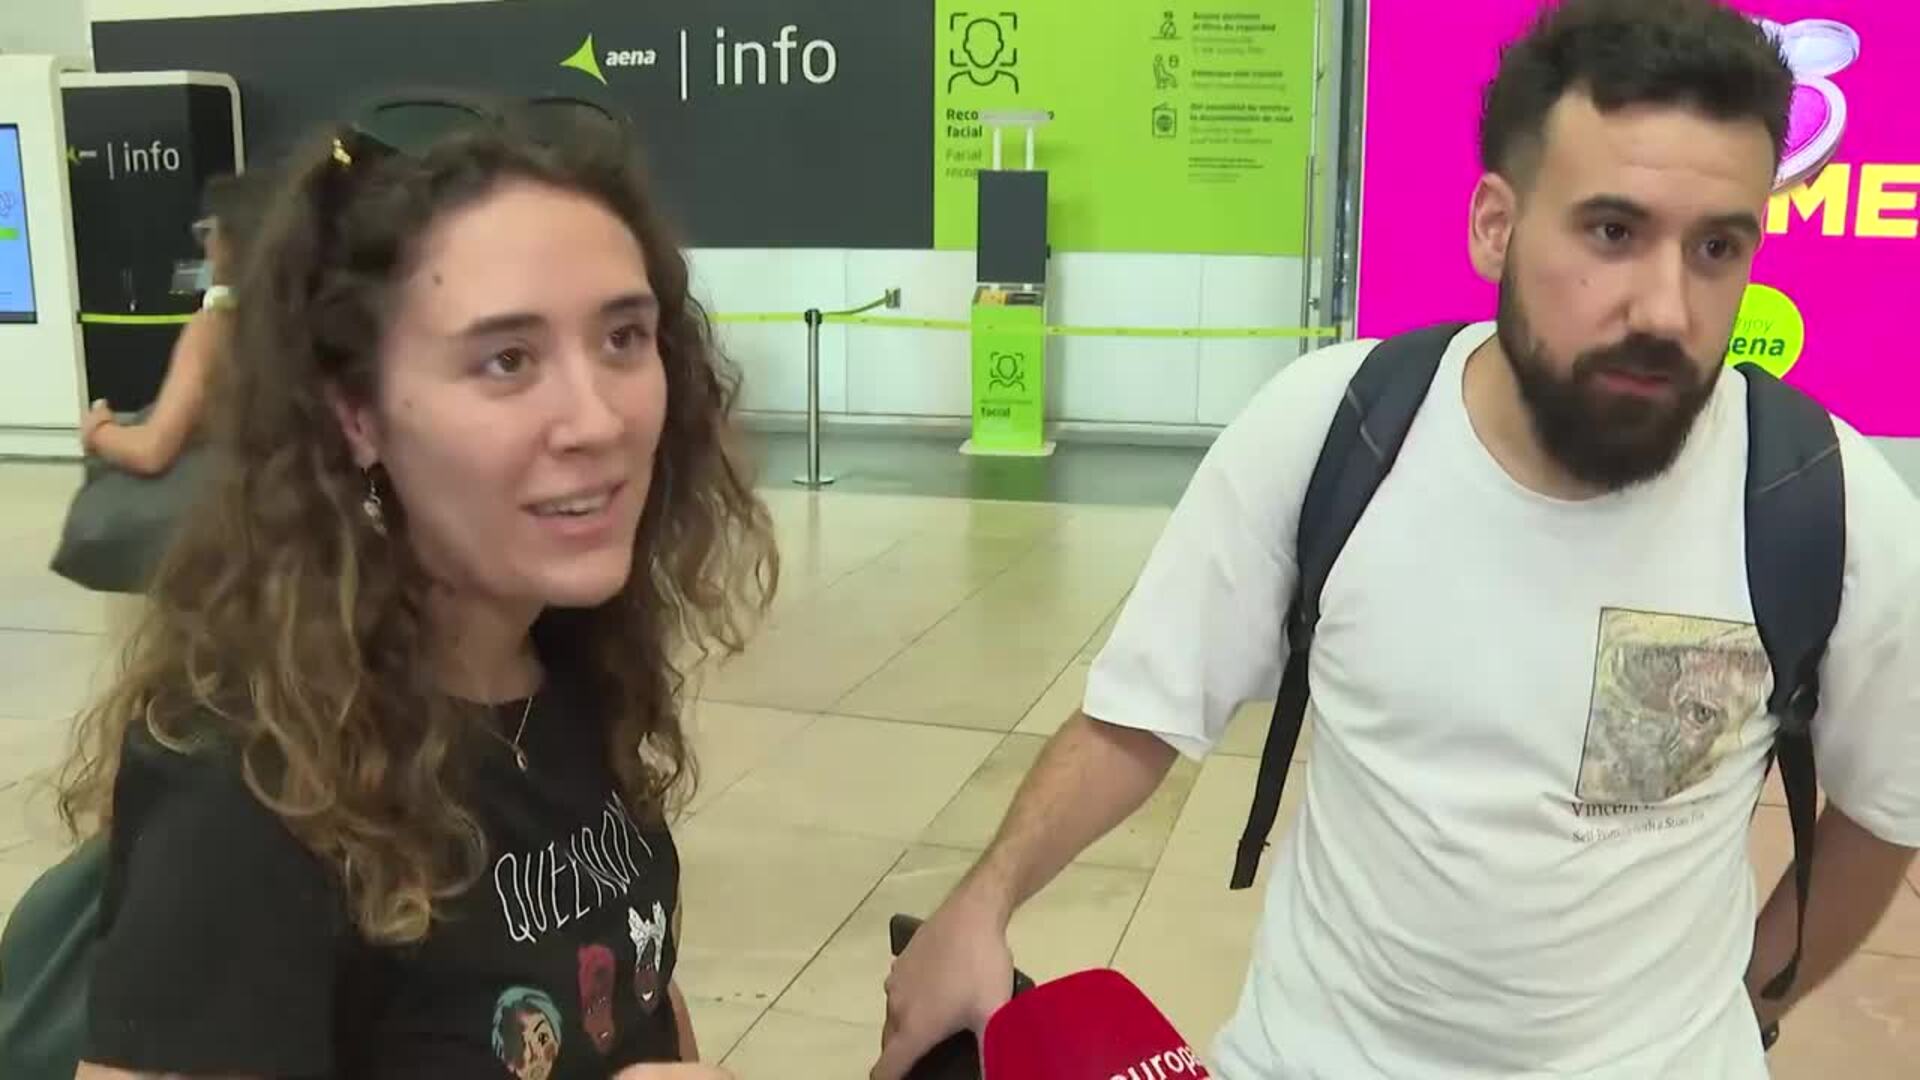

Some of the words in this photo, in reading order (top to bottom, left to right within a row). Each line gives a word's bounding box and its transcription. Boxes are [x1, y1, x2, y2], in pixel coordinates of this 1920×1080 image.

[605, 49, 657, 67] aena
[716, 24, 837, 85] info
[947, 125, 983, 138] facial
[123, 140, 180, 172] info
[1731, 337, 1785, 356] ena
